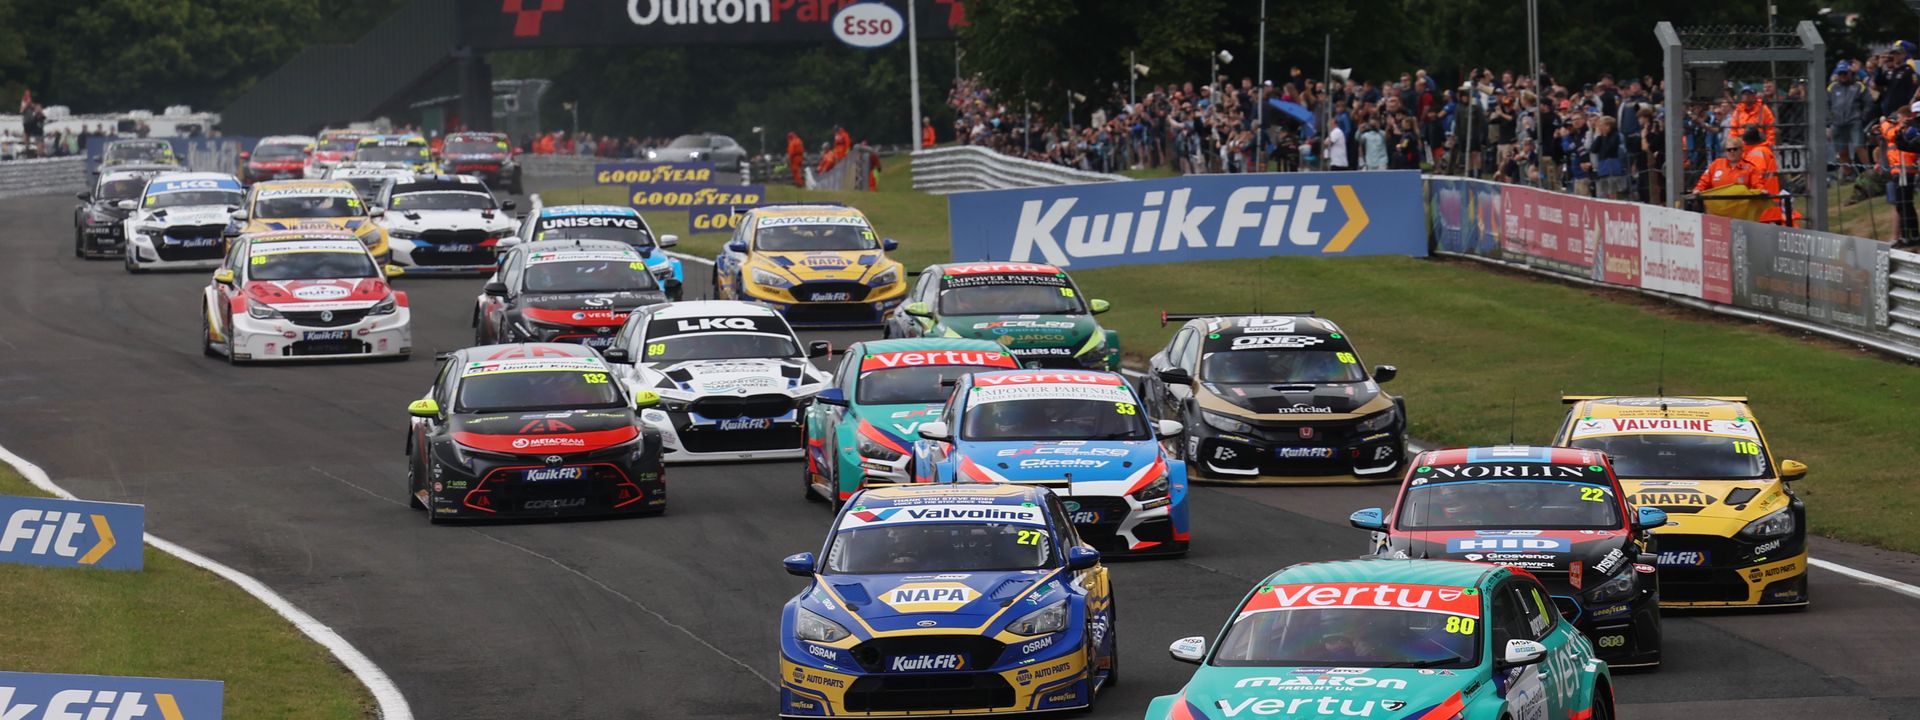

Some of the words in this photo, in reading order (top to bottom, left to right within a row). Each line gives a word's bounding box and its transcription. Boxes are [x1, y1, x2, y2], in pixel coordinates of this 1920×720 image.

[844, 16, 893, 35] Esso
[1780, 149, 1800, 169] 1.0
[598, 165, 711, 184] GOODYEAR
[166, 181, 217, 190] LKQ
[261, 187, 352, 197] CATACLEAN
[761, 216, 863, 225] CATACLEAN
[251, 256, 266, 265] 88
[629, 262, 645, 271] 40
[806, 257, 847, 267] NAPA
[947, 275, 1005, 284] EMPOWER
[1008, 275, 1066, 284] PARTNERS
[811, 291, 845, 302] KwikFit
[1060, 287, 1075, 297] 18
[677, 318, 758, 332] LKQ
[307, 330, 343, 340] KwikFit
[1233, 335, 1300, 346] ONE
[648, 343, 666, 356] 99
[1010, 348, 1049, 356] MILLERS
[876, 350, 985, 367] vertu
[1337, 351, 1356, 364] 66
[583, 373, 609, 384] 132
[980, 373, 1097, 385] vertu
[976, 385, 1049, 397] EMPOWER
[1054, 386, 1128, 397] PARTNERS
[1115, 402, 1136, 416] 33
[1278, 405, 1332, 414] metclad
[720, 418, 765, 431] KwikFit
[1612, 418, 1714, 432] VALVOLINE
[1280, 446, 1329, 459] KwikFit
[1733, 440, 1759, 456] 116
[1019, 458, 1111, 468] Ciceley
[527, 469, 577, 483] KwikFit
[1430, 464, 1584, 478] NORLIN
[1579, 486, 1604, 502] 22
[1640, 493, 1704, 505] NAPA
[524, 498, 586, 509] COROLLA
[907, 508, 1034, 521] Valvoline
[0, 509, 86, 557] Fit
[1016, 530, 1041, 546] 27
[1459, 539, 1560, 550] HID
[1754, 540, 1780, 555] OSRAM
[1780, 563, 1796, 574] PARTS
[895, 588, 965, 603] NAPA
[1273, 584, 1433, 608] vertu
[1593, 605, 1627, 617] GOODYEAR
[1446, 616, 1475, 635] 80
[1022, 636, 1053, 654] OSRAM
[809, 644, 837, 661] OSRAM
[892, 653, 957, 671] KwikFit
[1034, 668, 1052, 679] AUTO
[1051, 662, 1070, 674] PARTS
[806, 674, 823, 685] AUTO
[823, 676, 844, 688] PARTS
[1218, 696, 1377, 717] vertu
